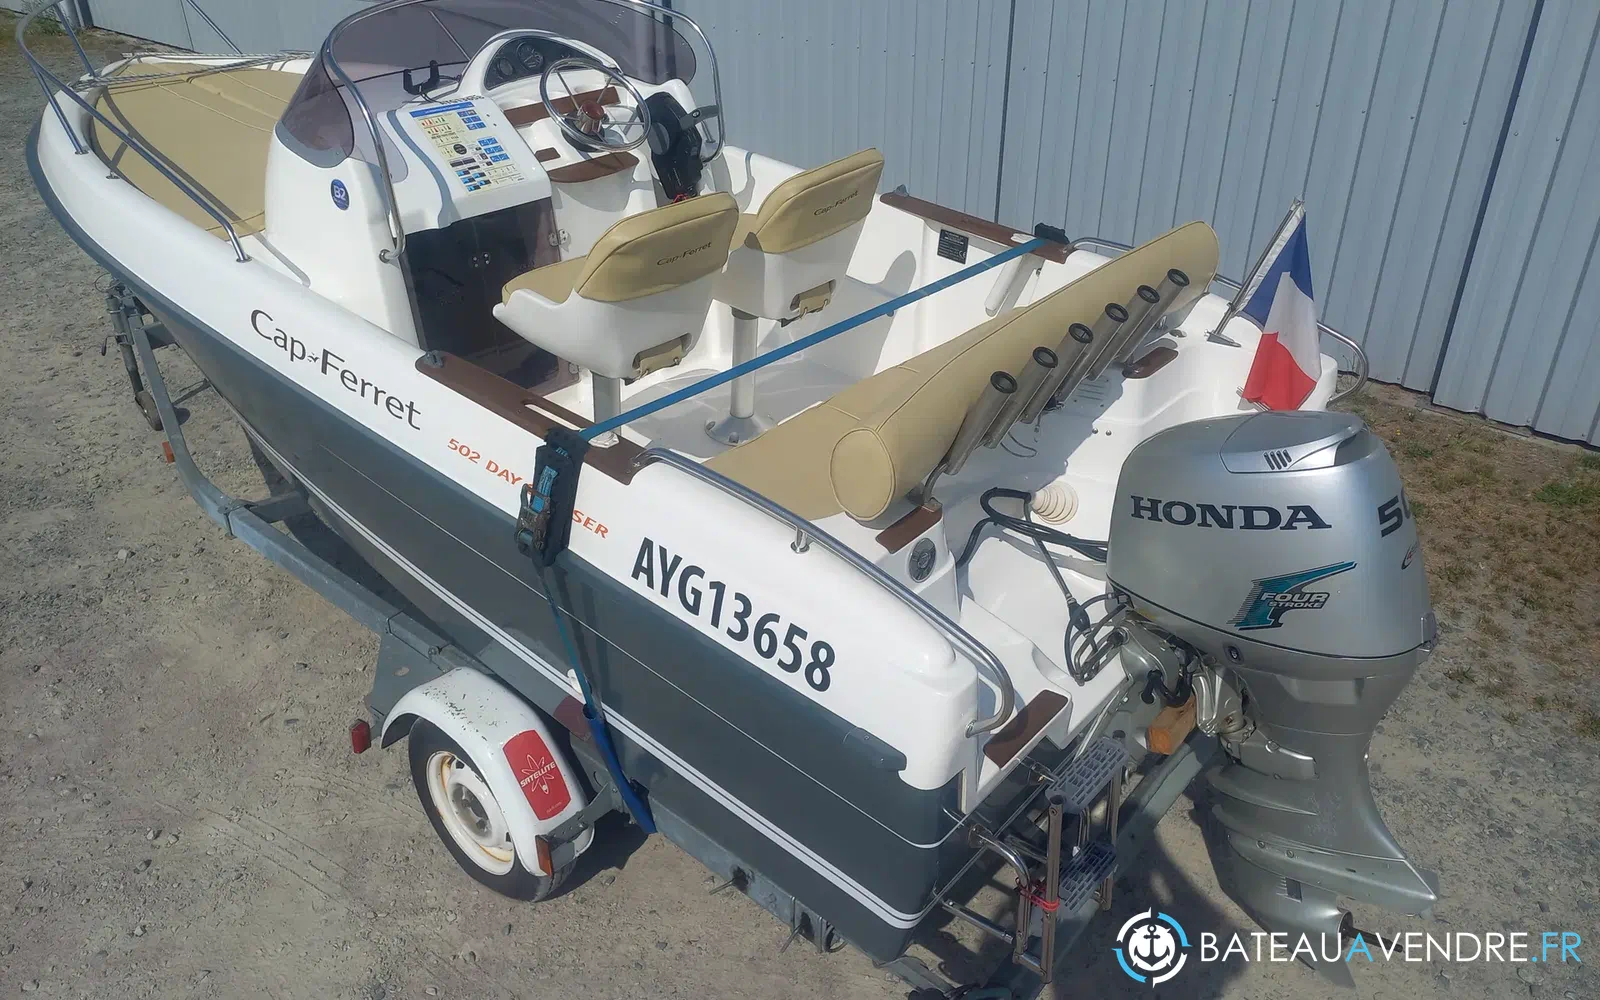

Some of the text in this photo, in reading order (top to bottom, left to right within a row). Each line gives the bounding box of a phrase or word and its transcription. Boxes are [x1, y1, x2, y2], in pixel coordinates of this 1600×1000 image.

[333, 185, 347, 201] B2
[447, 438, 481, 464] 502
[485, 459, 523, 486] DAY
[1130, 495, 1333, 531] HONDA
[1260, 592, 1330, 603] FOUR
[1267, 601, 1324, 609] STROKE
[631, 536, 836, 693] AYG13658
[519, 761, 557, 788] SATELLITE
